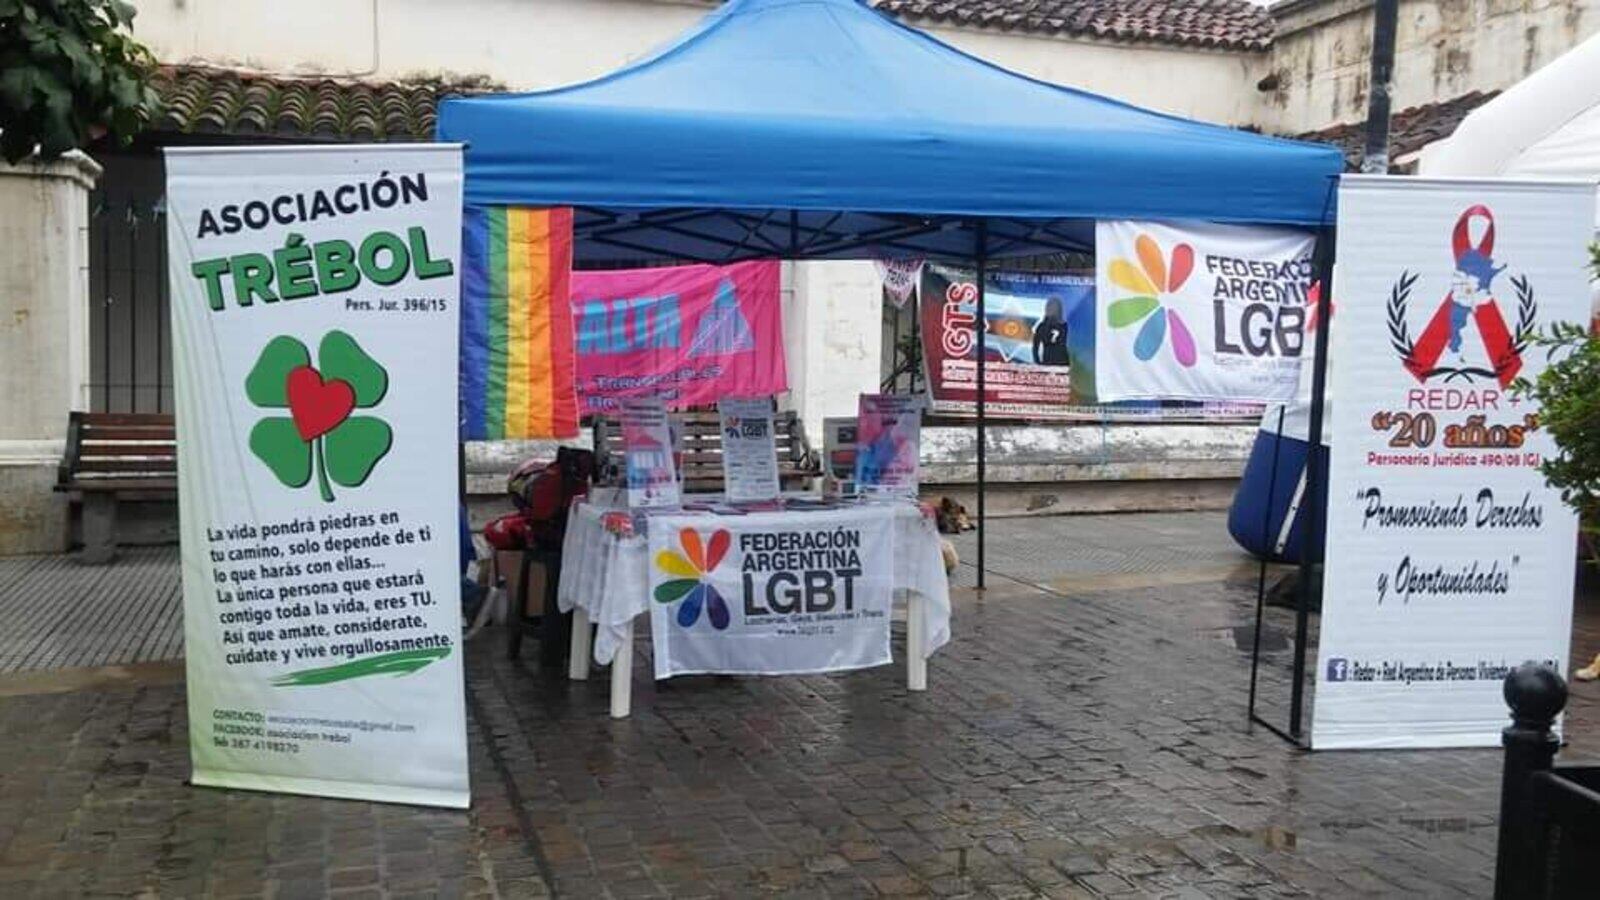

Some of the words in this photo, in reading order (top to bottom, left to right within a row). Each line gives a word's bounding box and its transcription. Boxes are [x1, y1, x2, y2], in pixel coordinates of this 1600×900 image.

[197, 171, 428, 238] ASOCIACIÓN
[191, 226, 454, 311] TRÉBOL
[346, 298, 374, 311] Pers.
[403, 298, 446, 313] 396/15
[573, 293, 680, 356] ALTA
[1213, 299, 1305, 357] LGB
[1408, 389, 1499, 410] REDAR
[1476, 487, 1542, 528] Derechos
[207, 527, 224, 542] La
[226, 523, 257, 540] vida
[262, 517, 315, 540] pondrá
[320, 512, 376, 534] piedras
[380, 511, 399, 525] en
[740, 525, 860, 552] FEDERACIÓN
[211, 549, 225, 562] tu
[228, 543, 285, 561] camino,
[289, 538, 321, 555] solo
[324, 530, 390, 553] depende
[395, 528, 415, 544] de
[419, 525, 431, 541] ti
[213, 567, 227, 583] lo
[230, 568, 257, 585] que
[260, 561, 302, 578] harás
[306, 560, 332, 574] con
[742, 549, 862, 573] ARGENTINA
[217, 589, 233, 603] La
[237, 585, 275, 602] única
[279, 581, 339, 602] persona
[343, 578, 371, 600] que
[376, 568, 424, 589] estará
[742, 569, 862, 616] LGBT
[1378, 572, 1389, 605] y
[220, 606, 273, 625] contigo
[275, 600, 311, 619] toda
[315, 600, 329, 616] la
[332, 597, 370, 614] vida,
[374, 596, 407, 611] eres
[248, 628, 275, 646] que
[281, 647, 291, 665] y
[295, 642, 327, 659] vive
[330, 634, 455, 659] orgullosamente.
